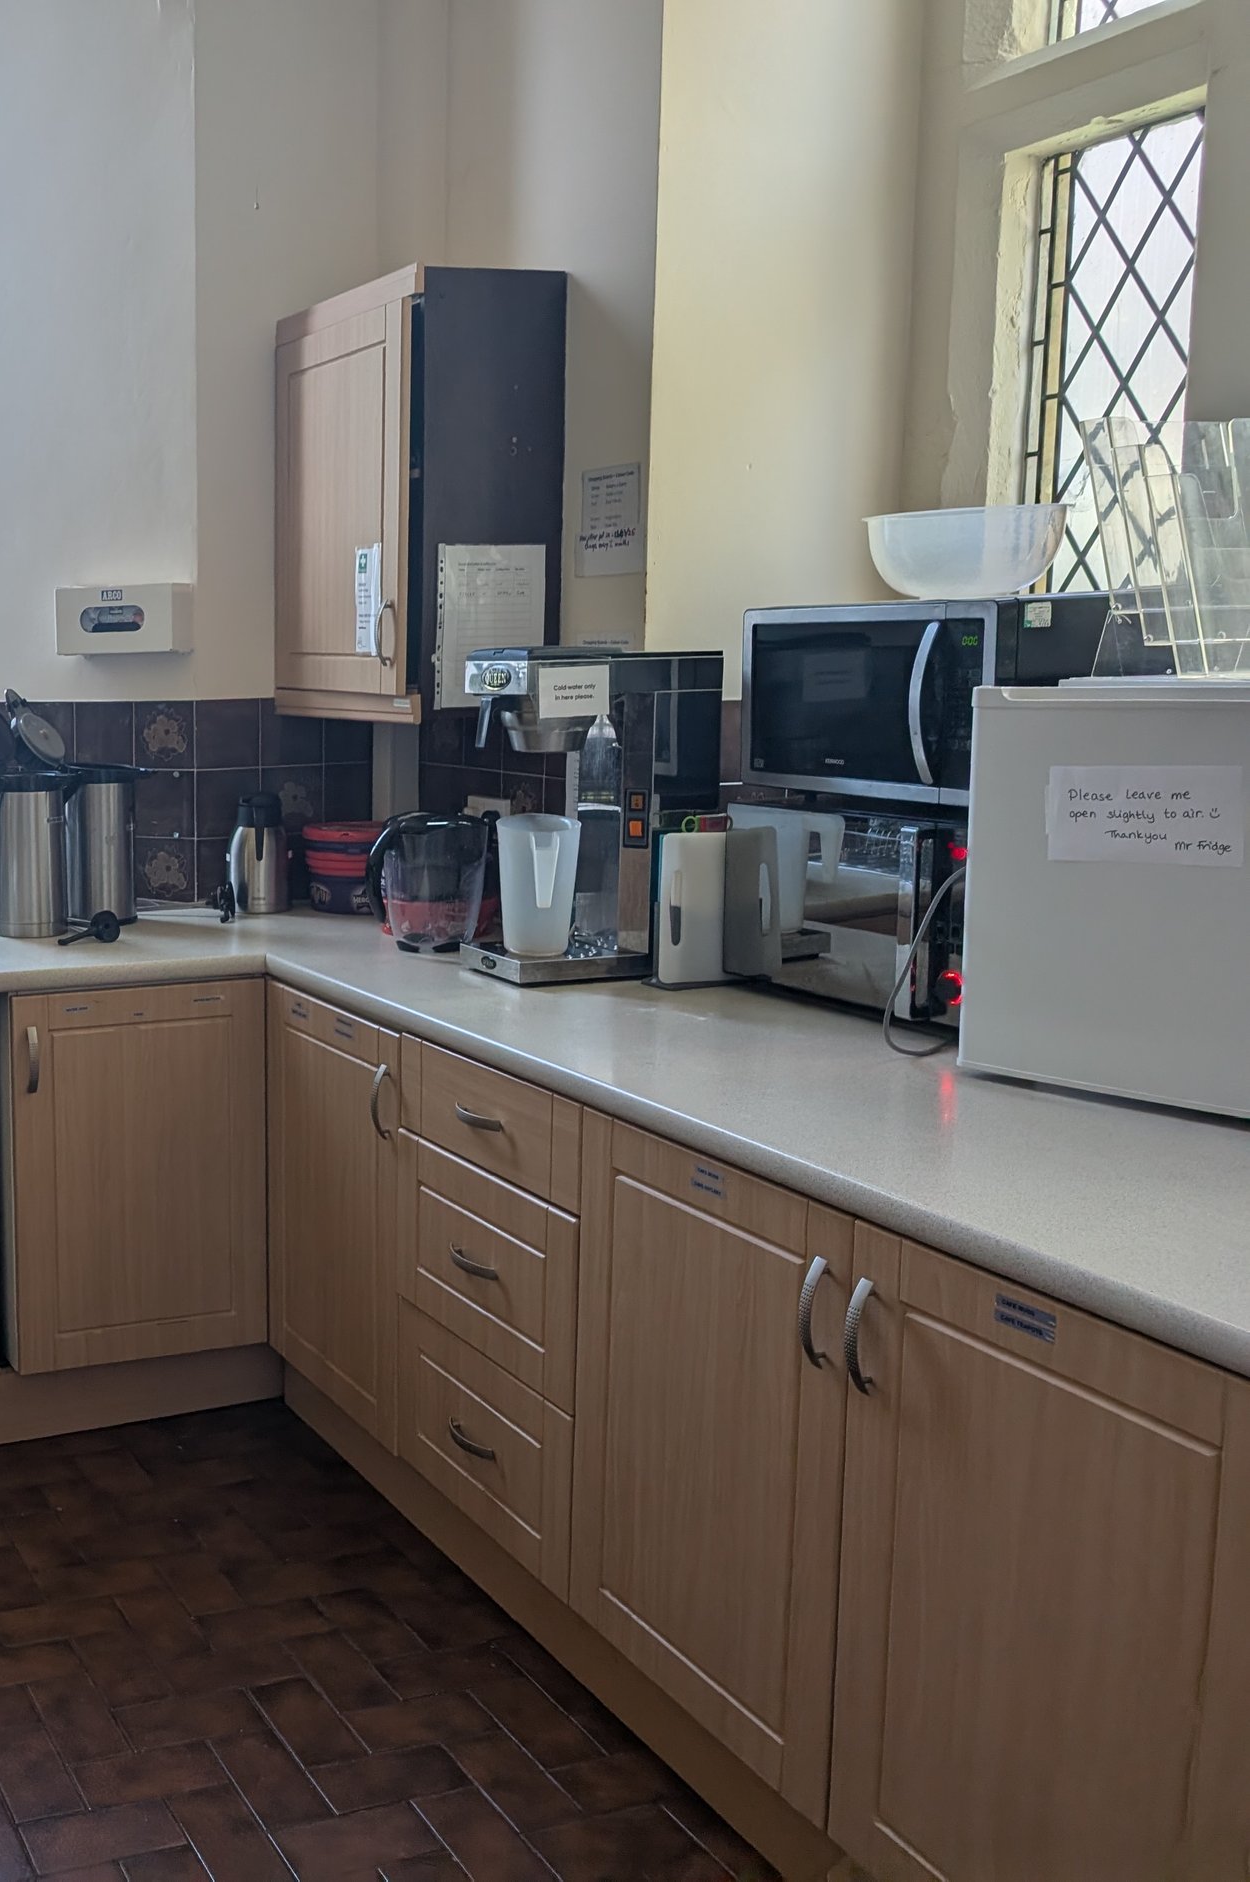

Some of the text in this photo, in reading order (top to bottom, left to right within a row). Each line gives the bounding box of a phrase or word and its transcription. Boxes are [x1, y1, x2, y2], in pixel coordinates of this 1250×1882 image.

[102, 591, 122, 600] ARCO
[485, 672, 507, 685] QUEEN
[574, 693, 594, 701] please.
[1068, 788, 1113, 802] Please
[1170, 790, 1191, 800] me
[1069, 810, 1097, 823] open
[1106, 810, 1155, 823] slightly
[1164, 808, 1177, 819] to
[1104, 829, 1167, 844] Thankyou
[1174, 840, 1232, 856] Mr Fridge
